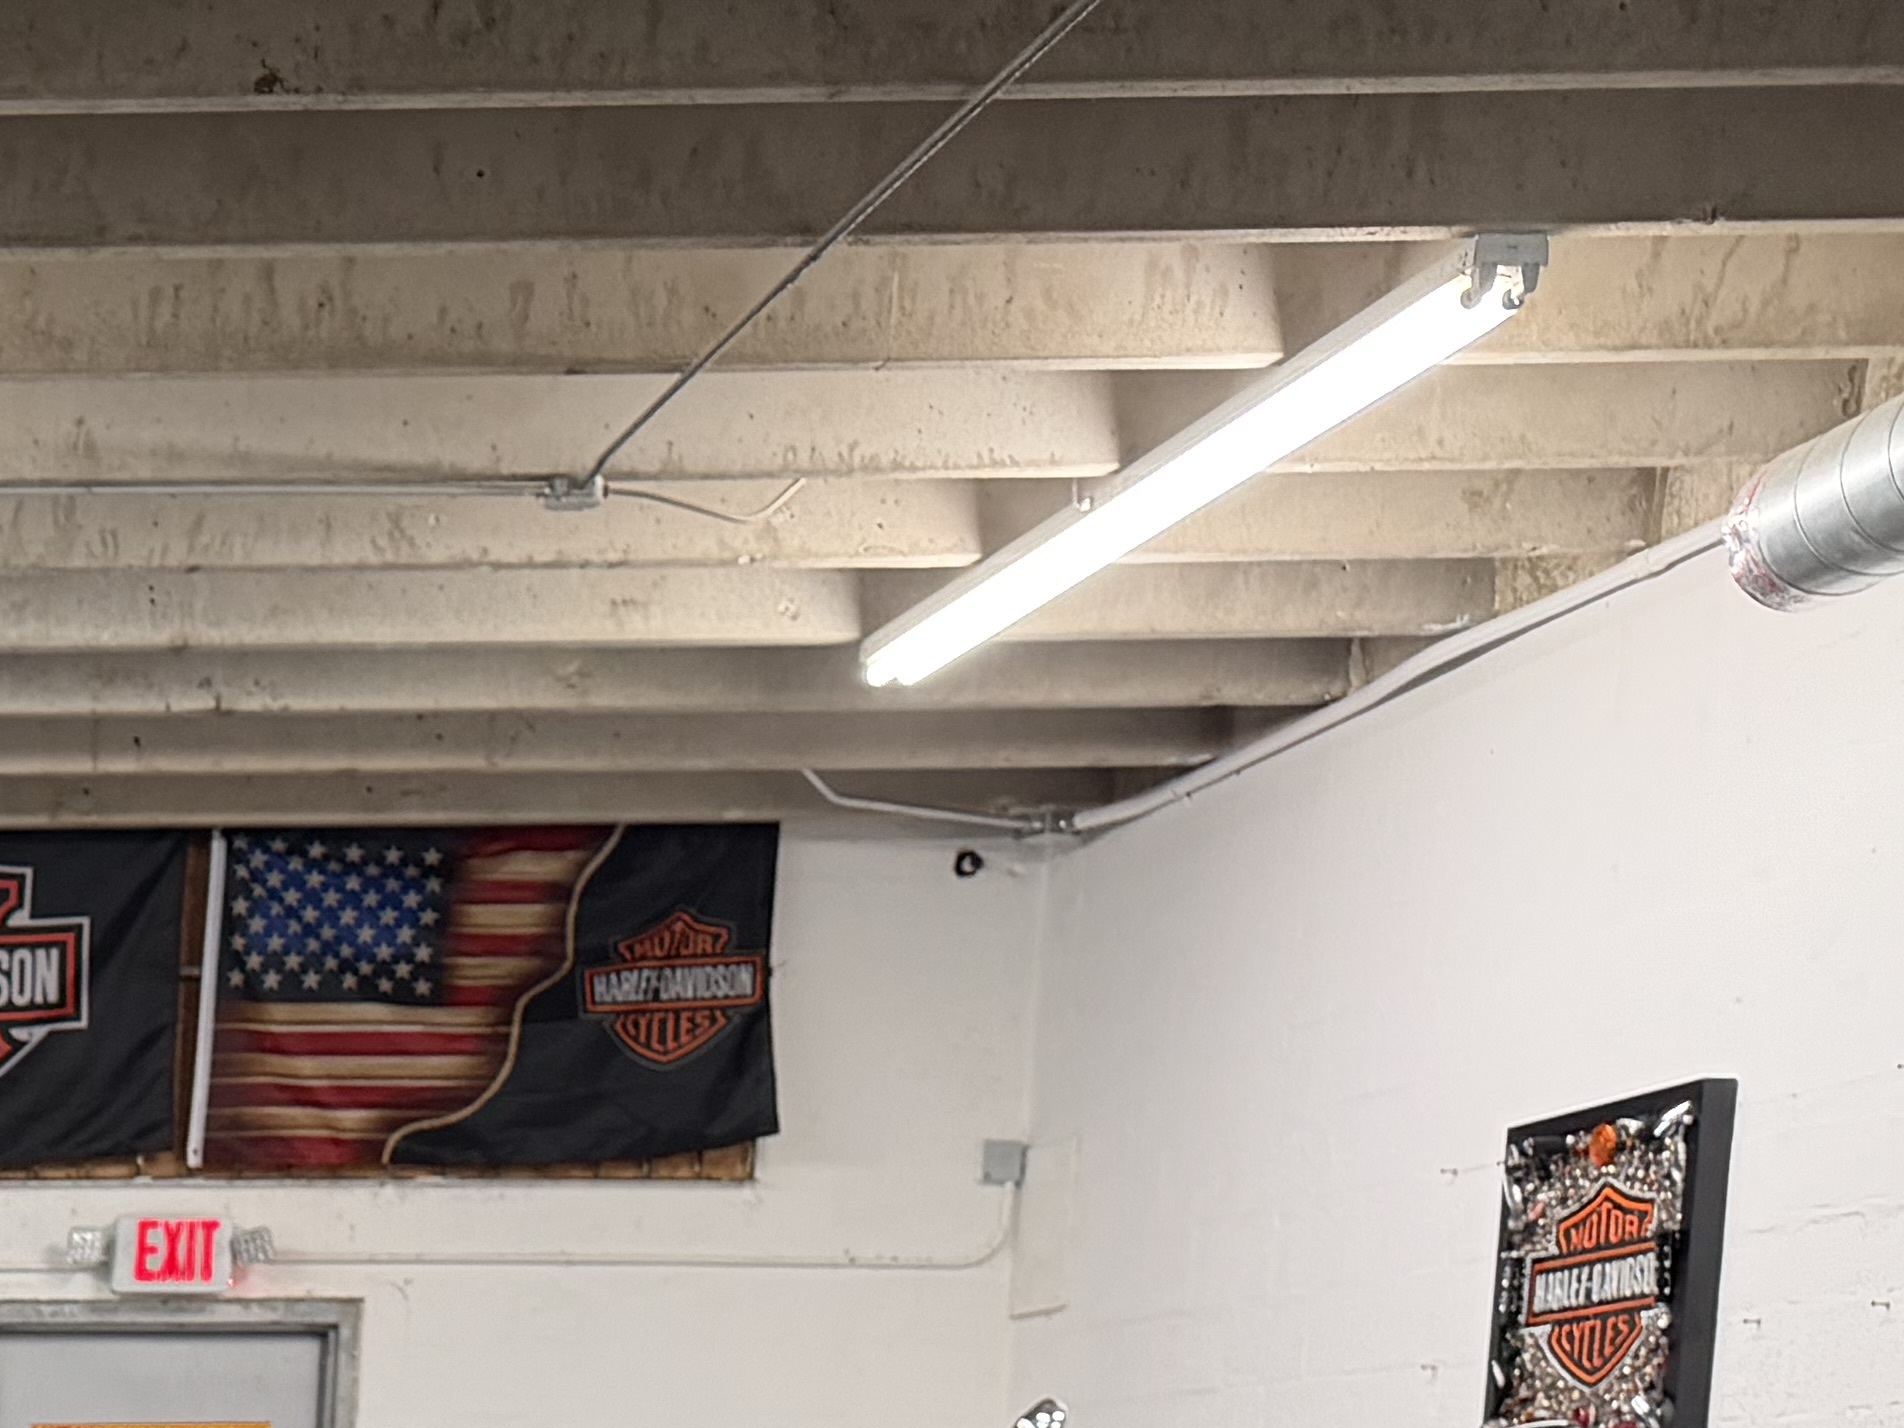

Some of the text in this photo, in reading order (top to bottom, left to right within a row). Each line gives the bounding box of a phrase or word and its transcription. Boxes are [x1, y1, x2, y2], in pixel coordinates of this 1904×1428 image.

[633, 920, 714, 958] MOTOR
[593, 962, 754, 1004] HARLEY-DAVIDSON
[625, 1010, 712, 1053] CYCLES
[1570, 1202, 1639, 1251] MOTOR
[133, 1219, 221, 1284] EXIT
[1533, 1251, 1658, 1314] HARLEY-DAVIDSO
[1561, 1314, 1629, 1369] CYCLES
